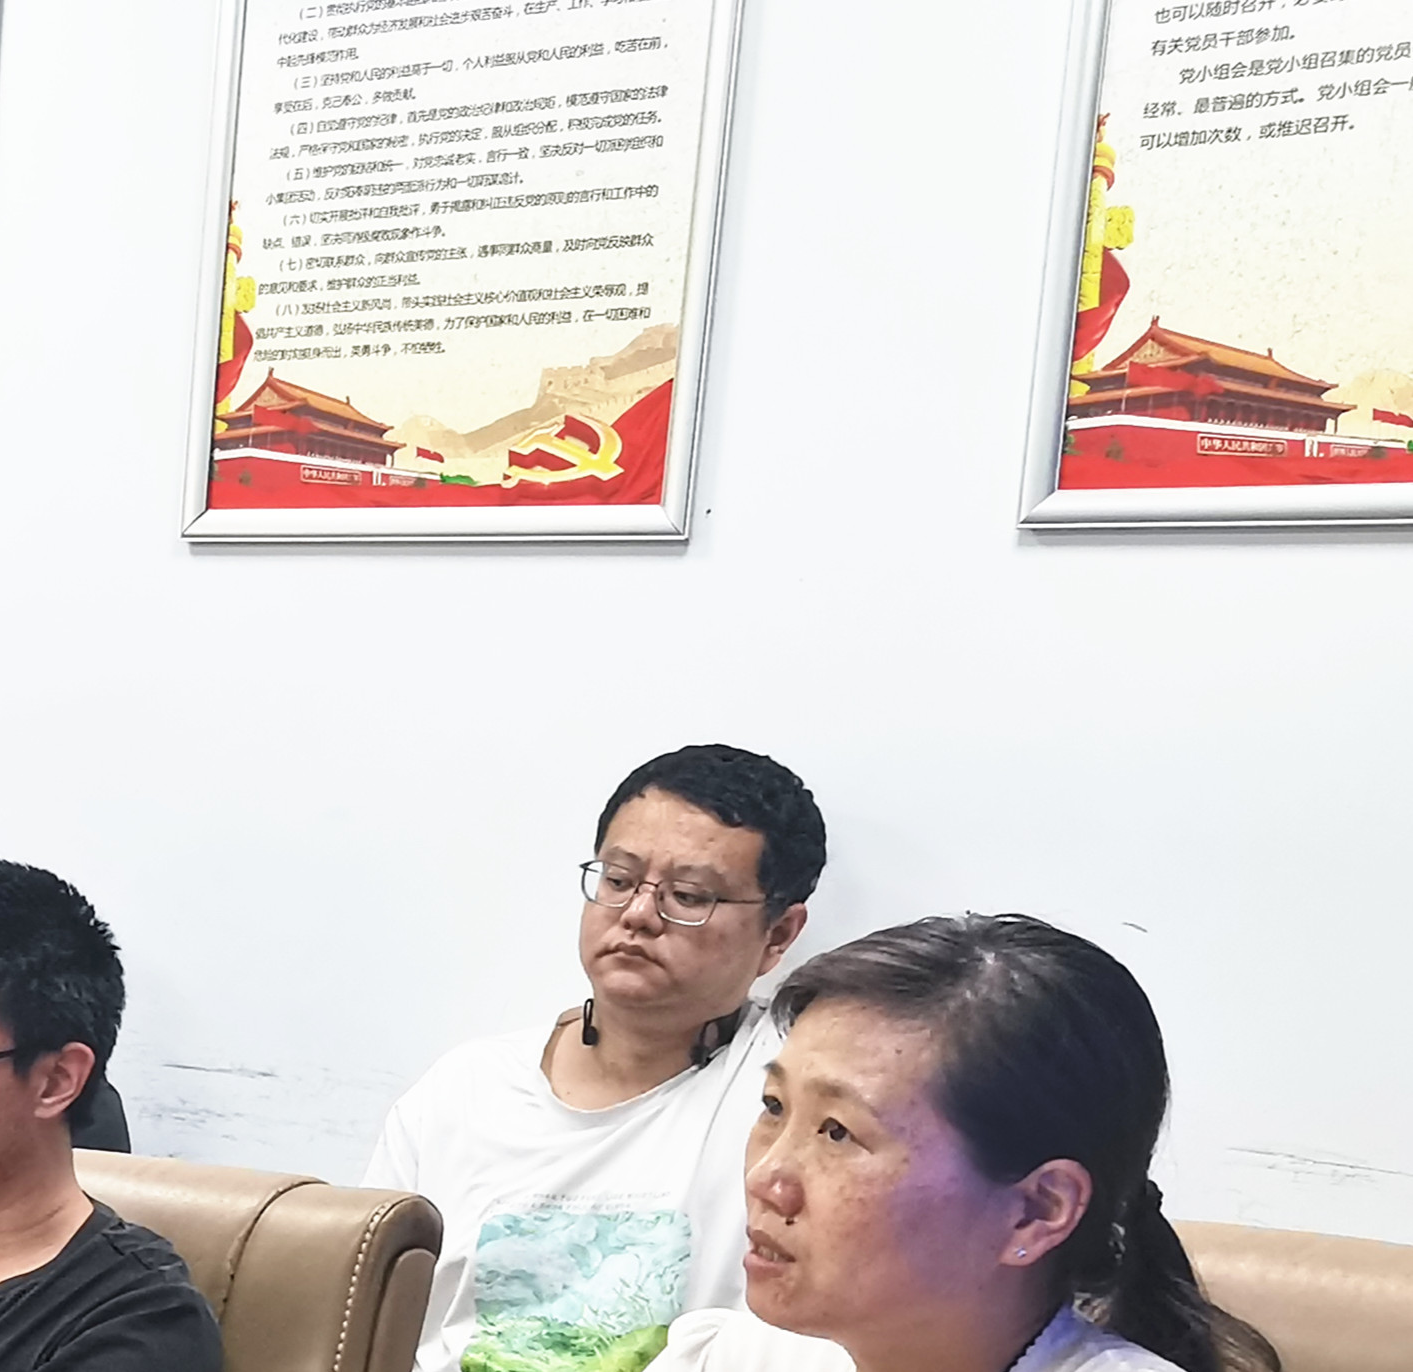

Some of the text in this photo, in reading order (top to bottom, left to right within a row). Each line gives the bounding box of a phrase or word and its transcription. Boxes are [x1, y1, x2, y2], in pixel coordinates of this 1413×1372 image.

[1143, 76, 1413, 119] 经常、最普遍的方式。党小组会一
